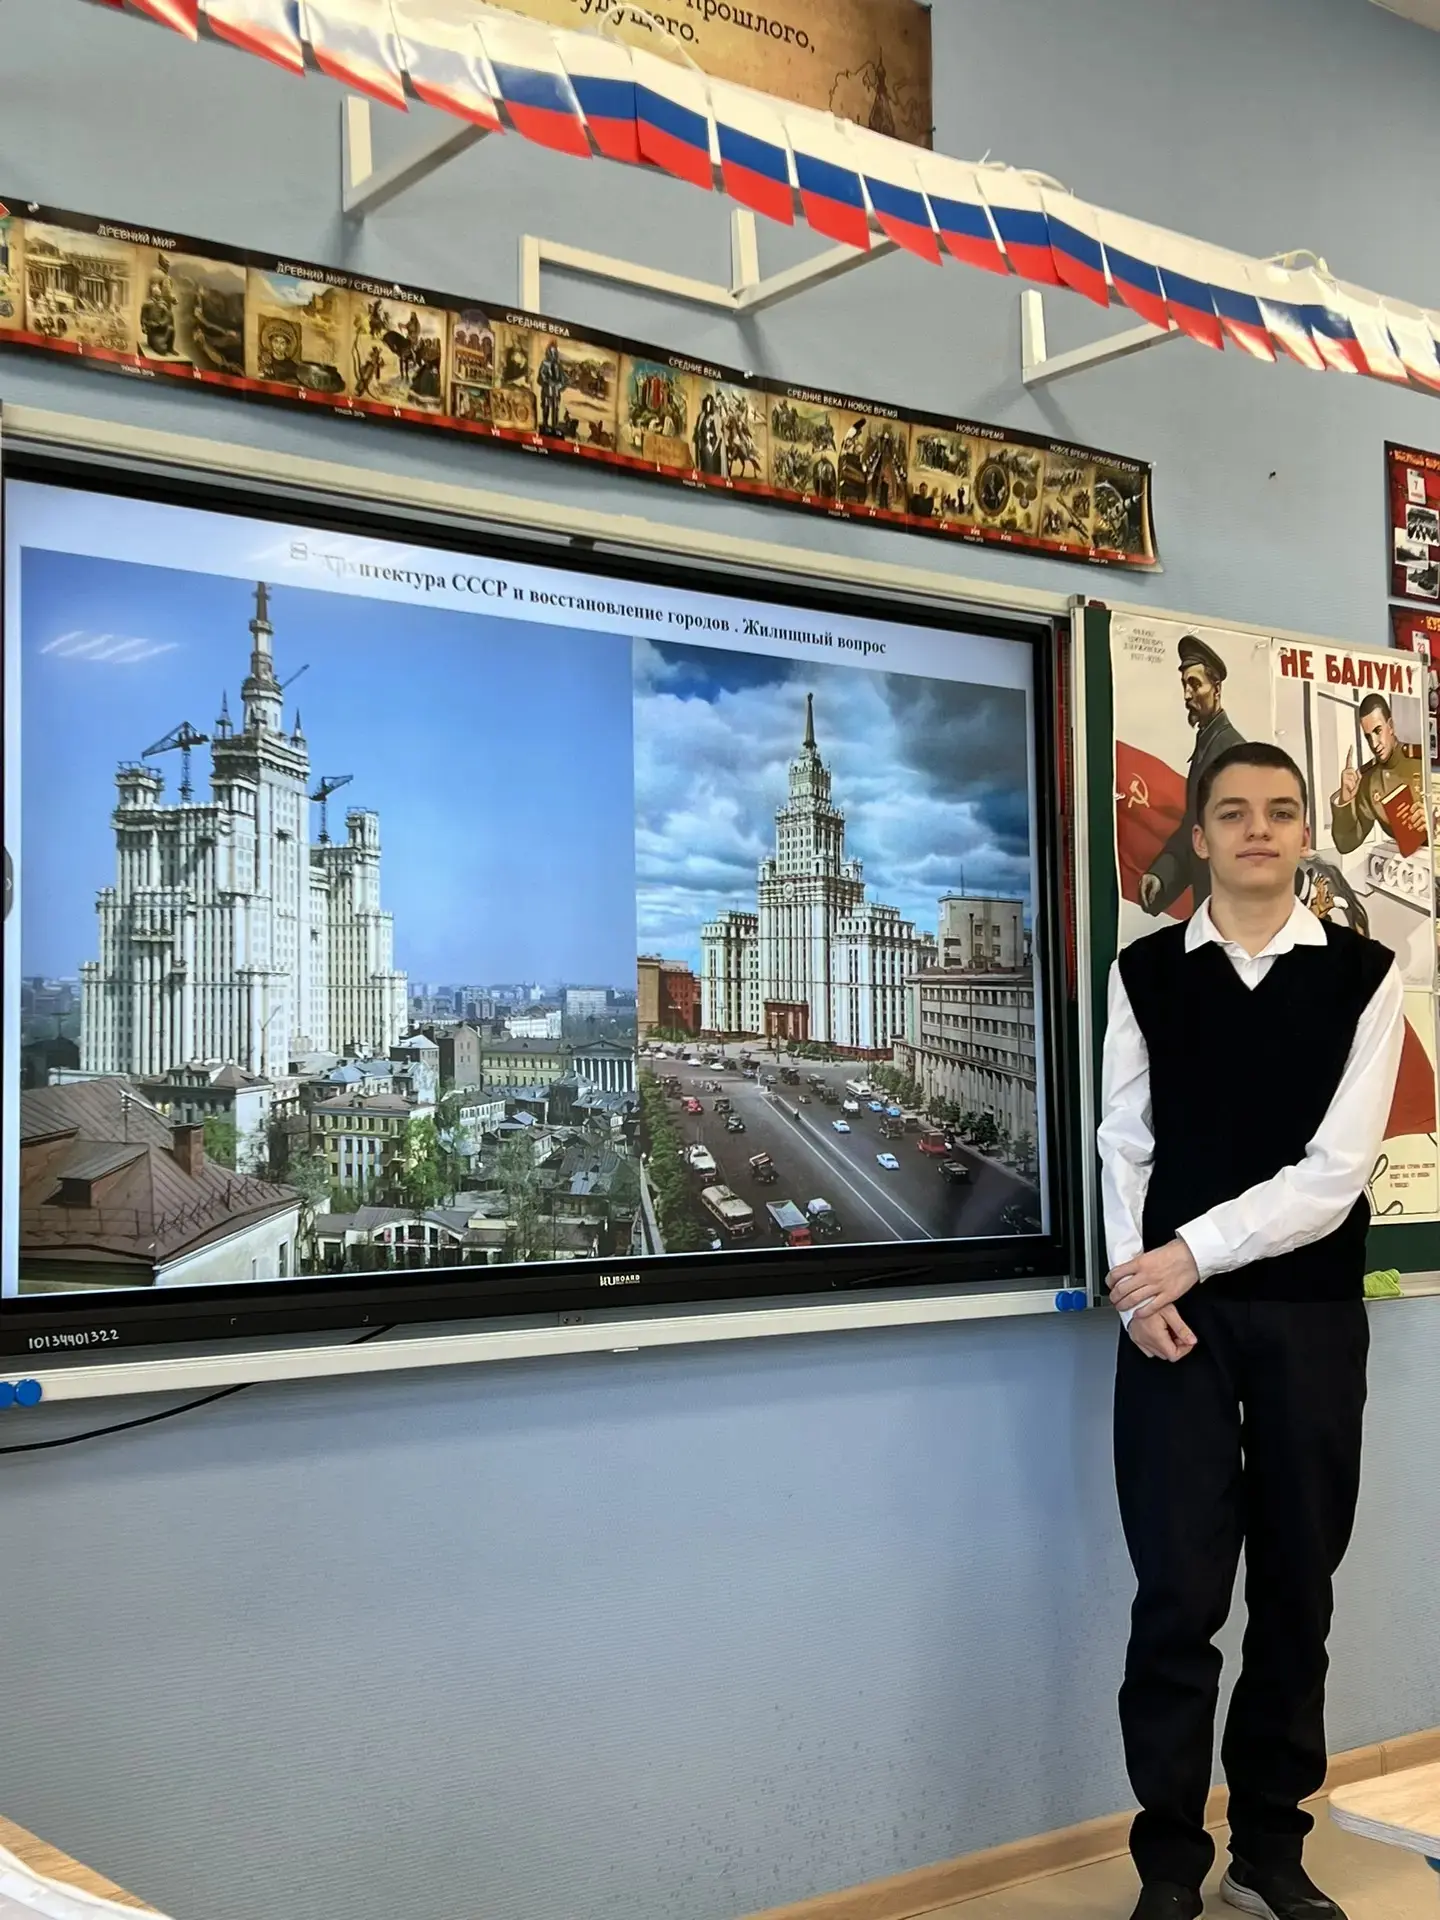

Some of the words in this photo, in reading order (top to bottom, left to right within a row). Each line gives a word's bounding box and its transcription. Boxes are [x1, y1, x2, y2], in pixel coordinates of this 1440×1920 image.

[573, 0, 699, 44] удущего.
[97, 223, 150, 244] ДРЕВНИЙ
[151, 234, 177, 249] МИР
[276, 261, 324, 281] ДРЕВНИЙ
[325, 272, 347, 284] МИР
[401, 292, 426, 304] ВЕКА
[506, 313, 547, 332] СРЕДНИЕ
[548, 323, 570, 337] ВЕКА
[668, 356, 702, 375] СРЕДНИЕ
[703, 366, 722, 379] ВЕКА
[787, 388, 822, 404] СРЕДНИЕ
[823, 395, 843, 407] ВЕКА
[848, 401, 872, 414] НОВОЕ
[873, 406, 898, 418] ВРЕМЯ
[955, 423, 980, 436] НОВОЕ
[980, 428, 1005, 440] ВРЕМЯ
[452, 573, 507, 598] СССР
[513, 586, 525, 601] и
[530, 590, 664, 622] восстановление
[668, 610, 730, 631] городов
[742, 617, 833, 647] Жилищный
[837, 635, 887, 656] вопрос
[1280, 647, 1315, 680] НЕ
[1325, 653, 1413, 696] БАЛУЙ!
[1368, 853, 1431, 894] СССР
